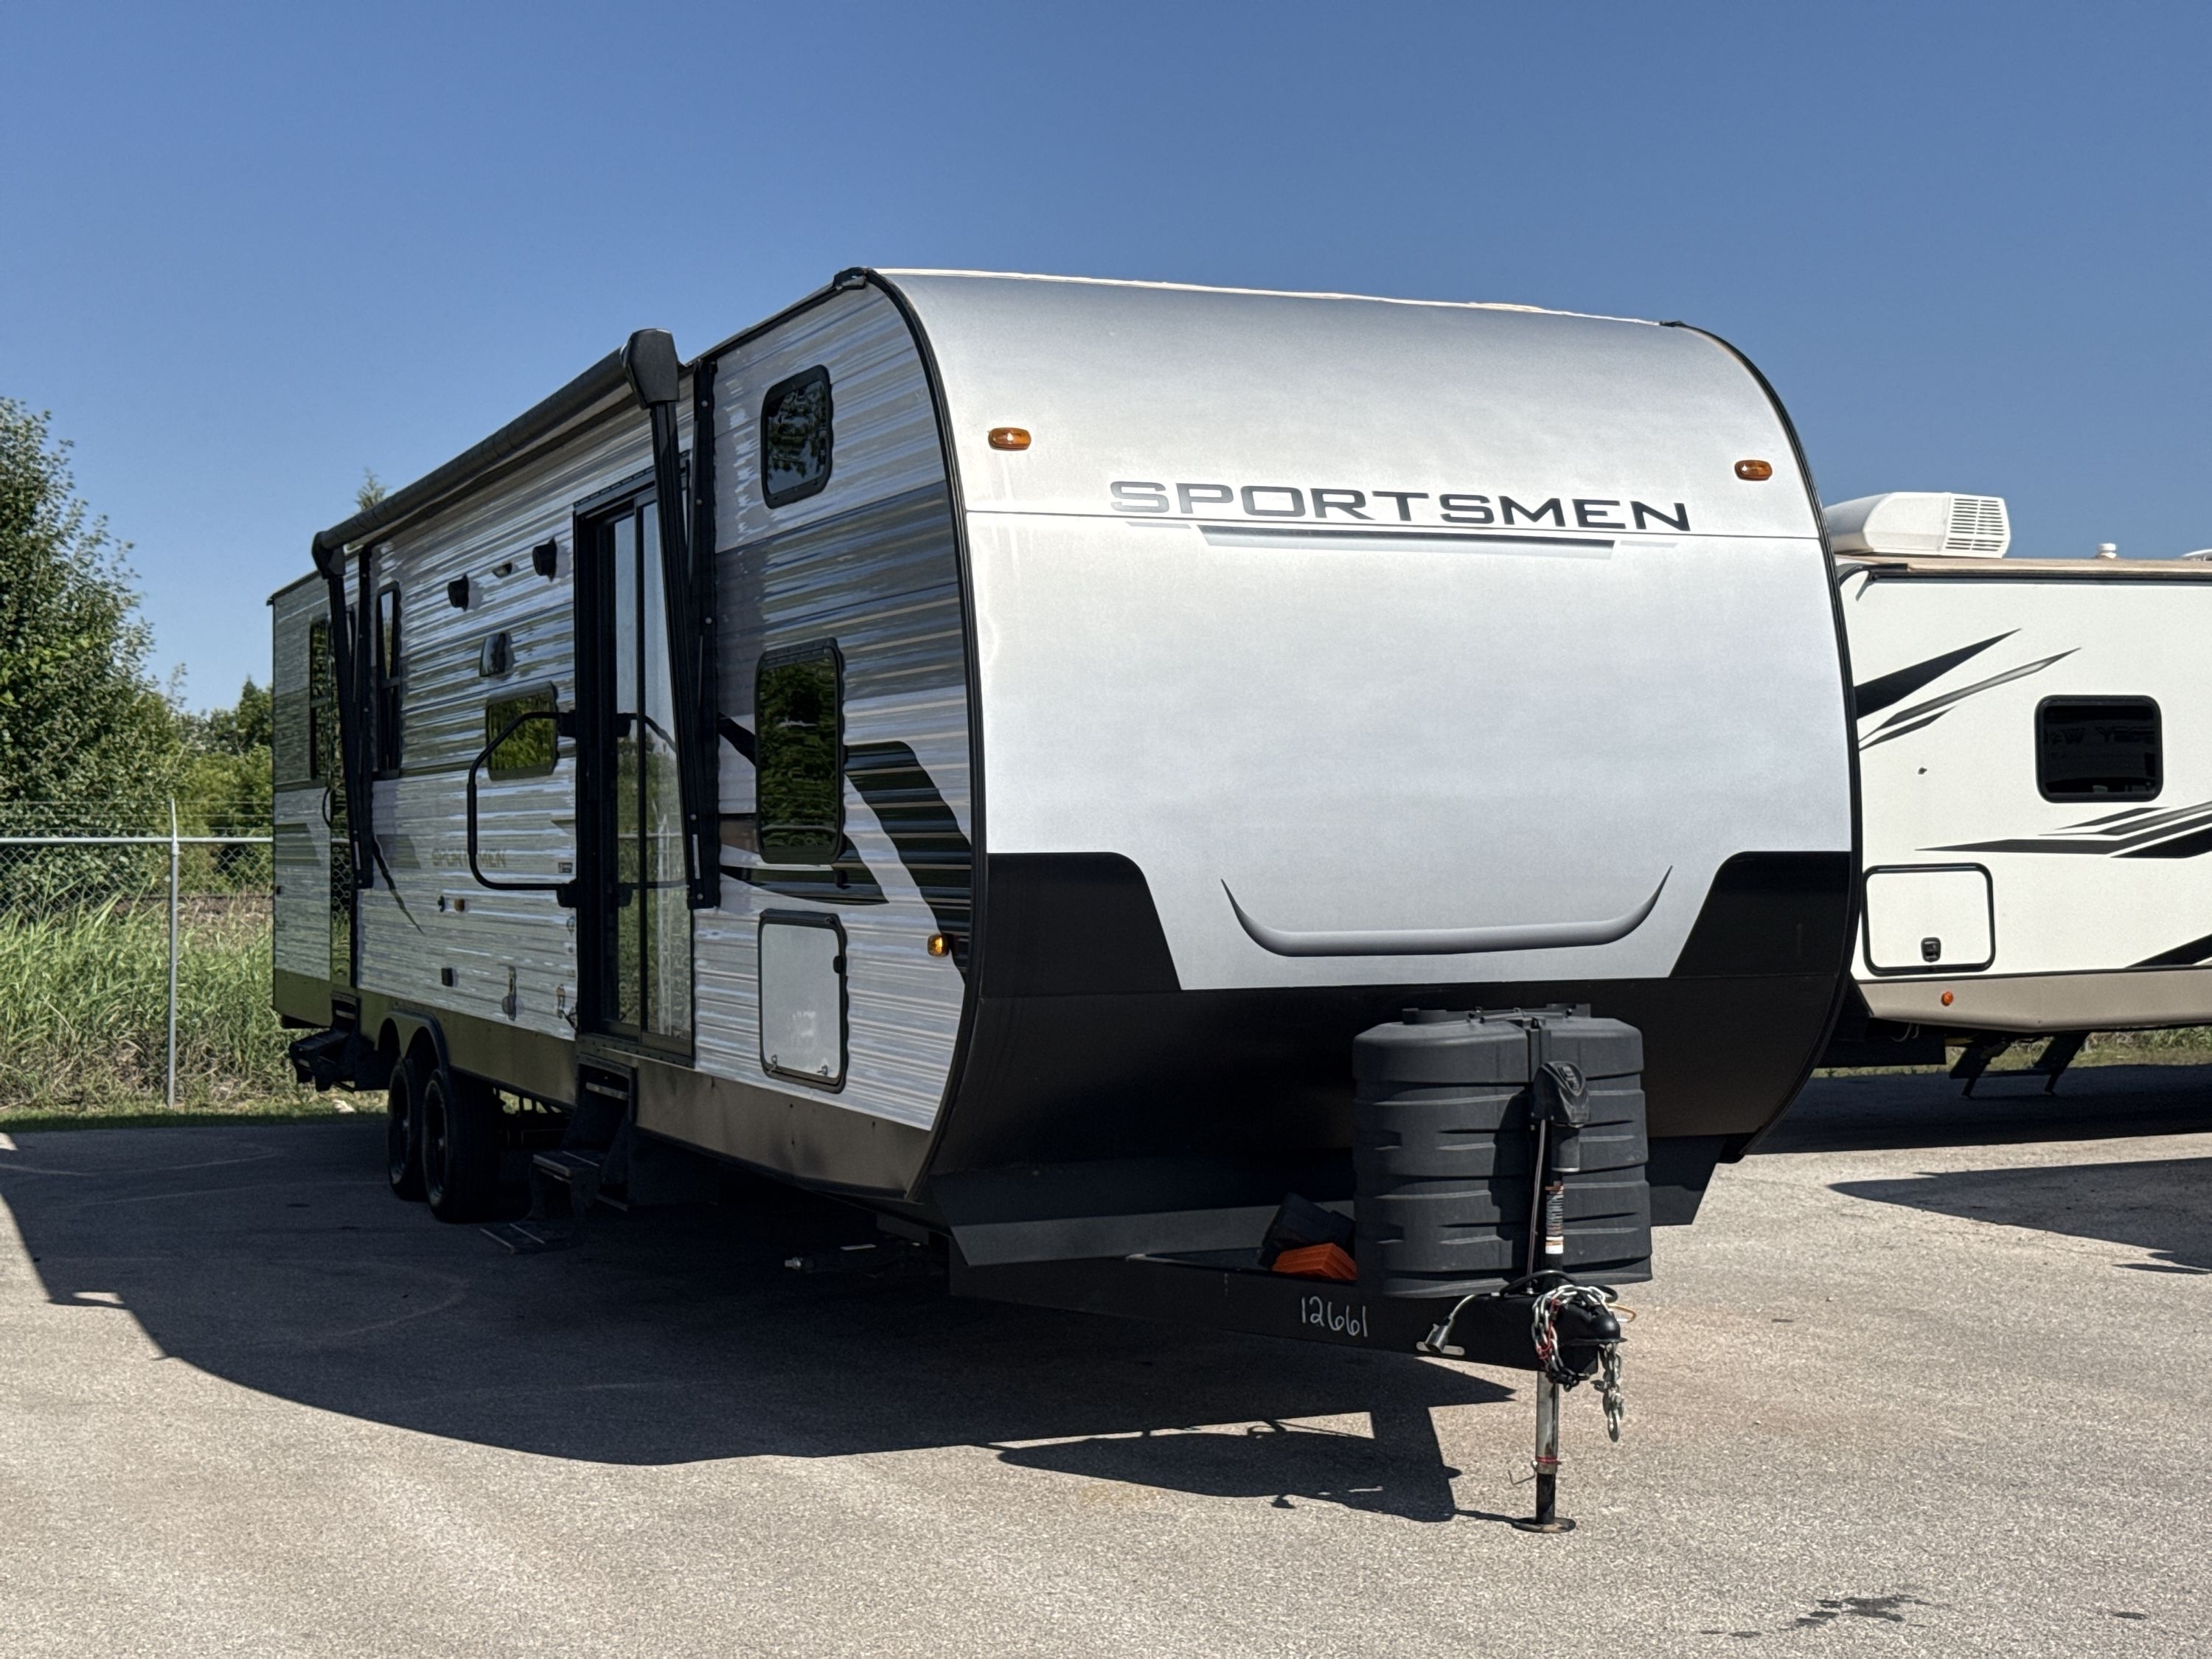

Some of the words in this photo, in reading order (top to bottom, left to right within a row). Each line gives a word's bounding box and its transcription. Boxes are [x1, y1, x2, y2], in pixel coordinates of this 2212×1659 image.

[1110, 480, 1691, 532] SPORTSMEN
[432, 848, 507, 868] SPORTMEN
[1301, 1295, 1368, 1338] 12661
